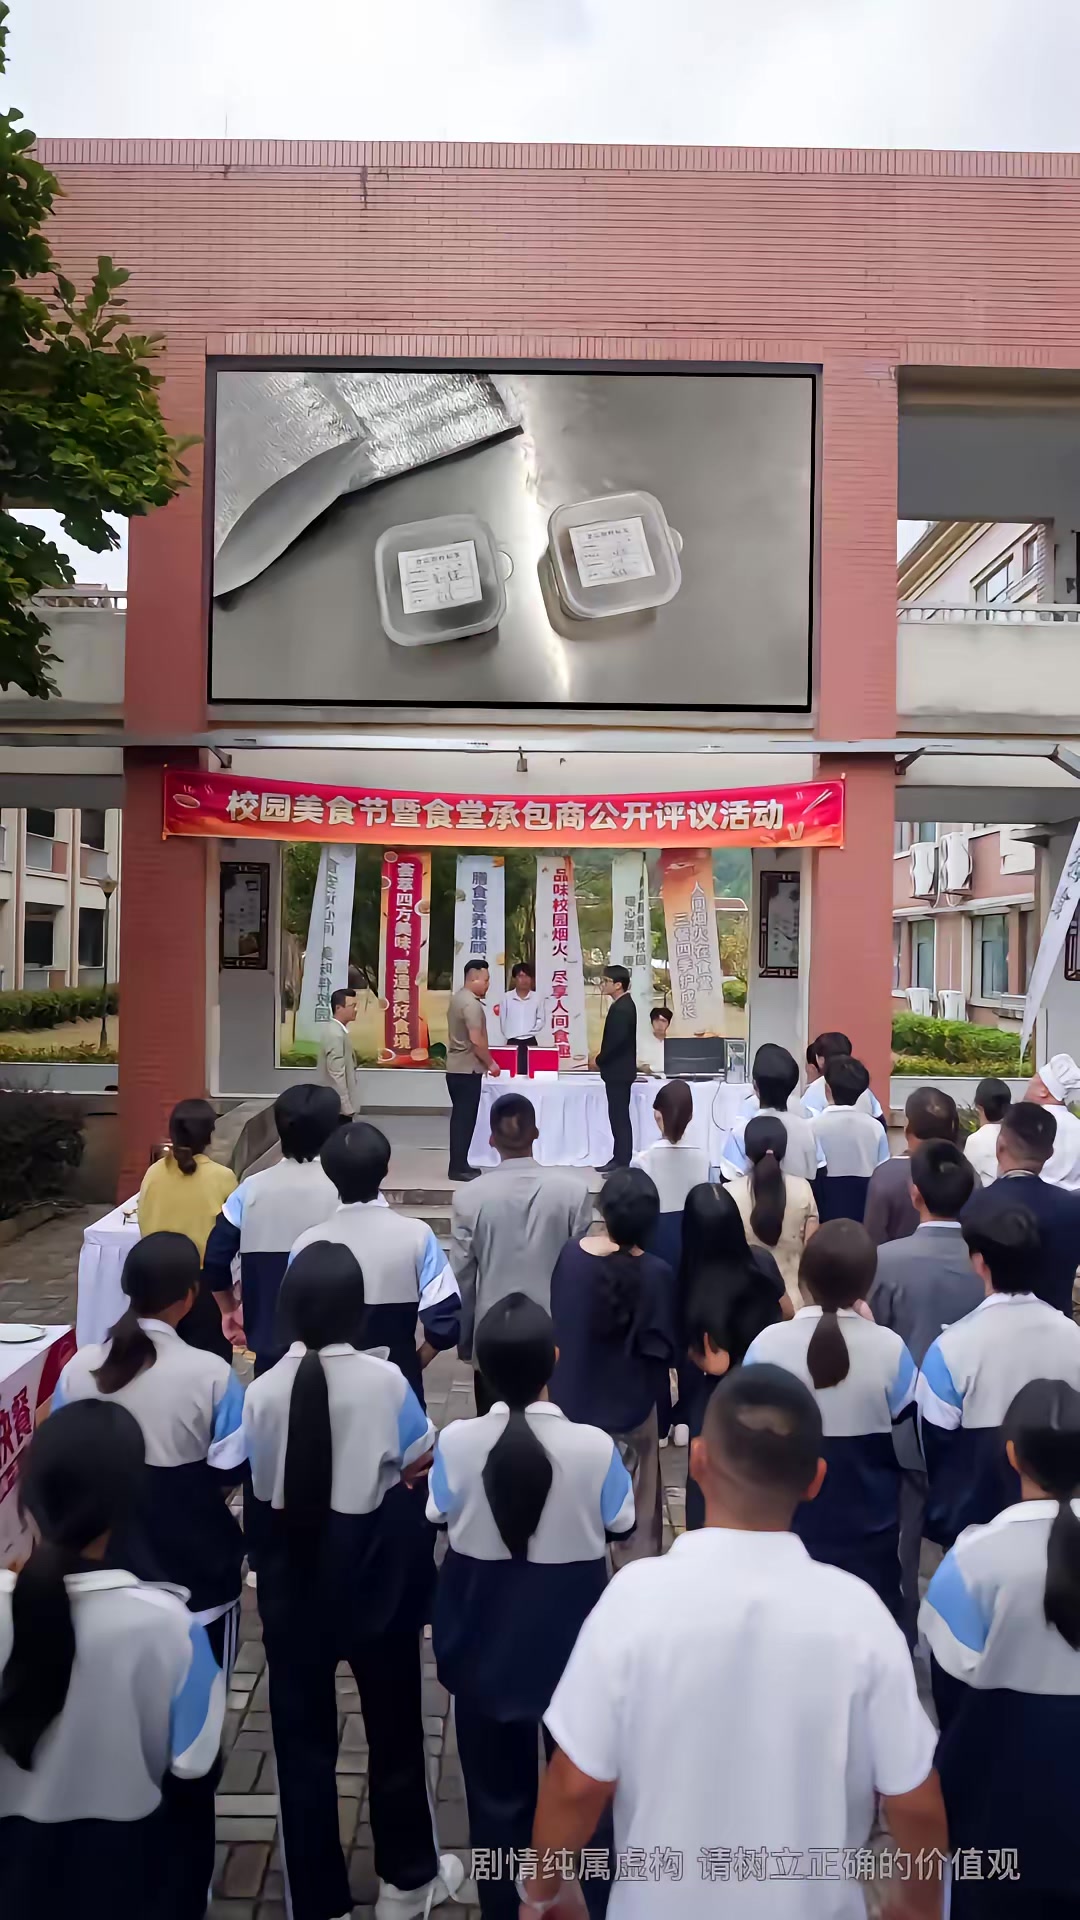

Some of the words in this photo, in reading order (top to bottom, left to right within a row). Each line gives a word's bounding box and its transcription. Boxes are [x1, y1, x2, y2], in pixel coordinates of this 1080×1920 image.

[226, 789, 784, 831] 校园美食节暨食堂承包商公开评议活动
